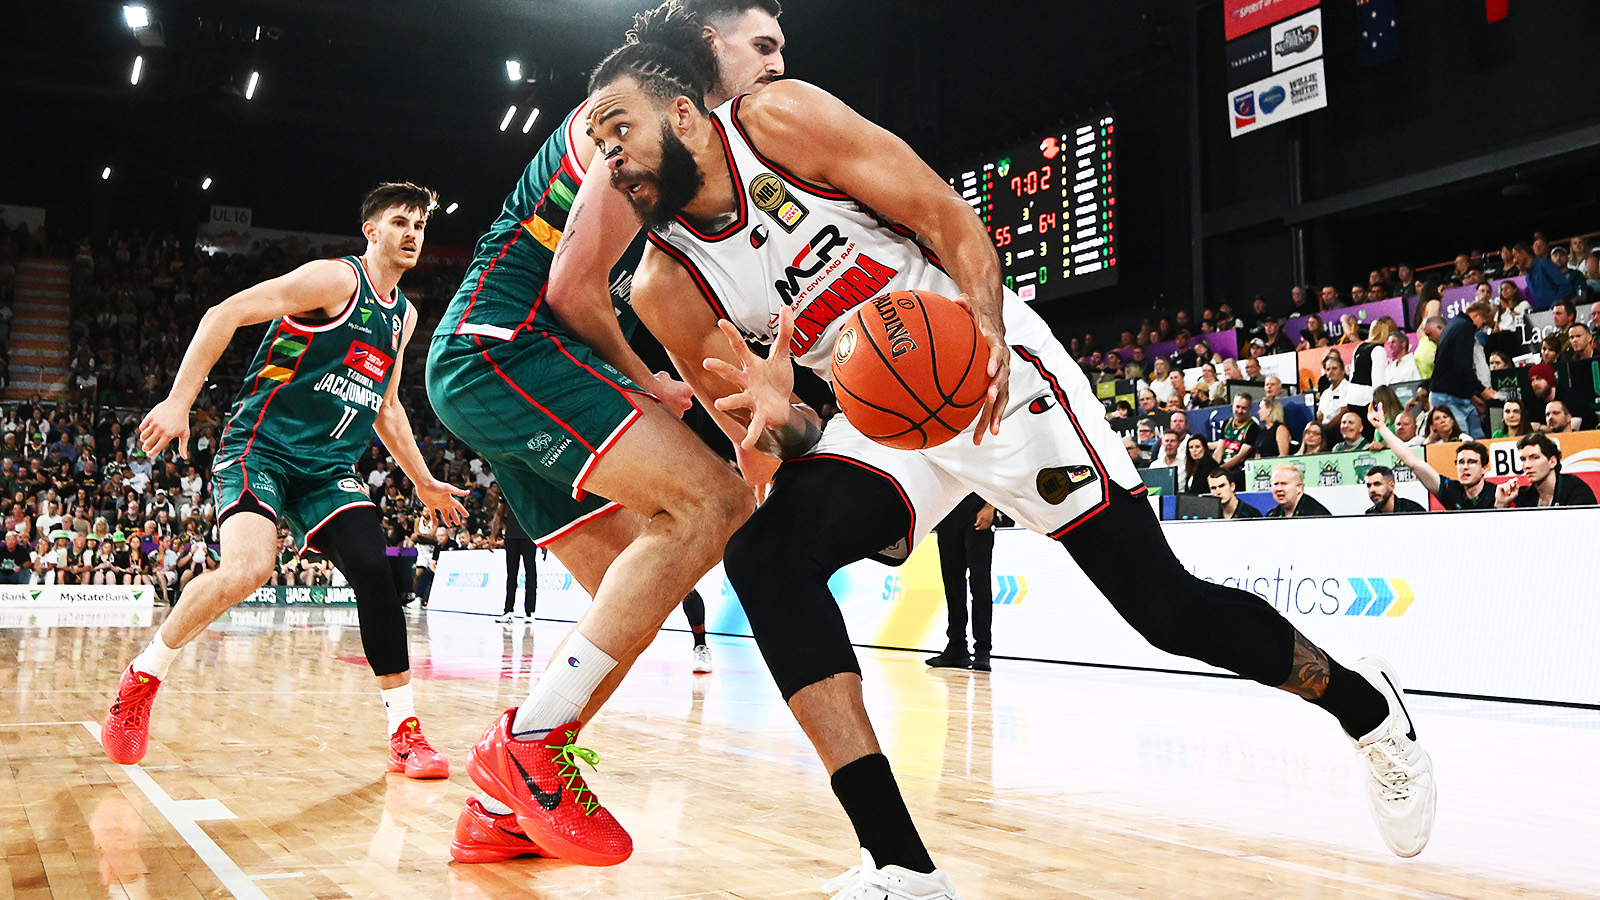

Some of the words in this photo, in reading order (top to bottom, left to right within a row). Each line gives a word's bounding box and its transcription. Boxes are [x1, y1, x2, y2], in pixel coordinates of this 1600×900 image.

[755, 181, 779, 204] NBL
[1011, 165, 1051, 197] 7:02
[212, 207, 249, 224] UL16
[1022, 207, 1029, 221] 3
[1038, 211, 1056, 234] 64
[995, 225, 1012, 248] 55
[1005, 251, 1013, 267] 3
[1039, 241, 1048, 257] 3
[774, 224, 849, 306] MCR
[806, 275, 826, 292] CIVIL
[825, 258, 842, 276] AND
[840, 242, 856, 260] RAIL
[1039, 265, 1048, 285] 0
[790, 252, 898, 358] LLAWARRA
[329, 404, 358, 440] 11
[544, 438, 572, 468] TASMANIA
[59, 592, 130, 603] MyStateBank
[285, 587, 313, 604] JACK
